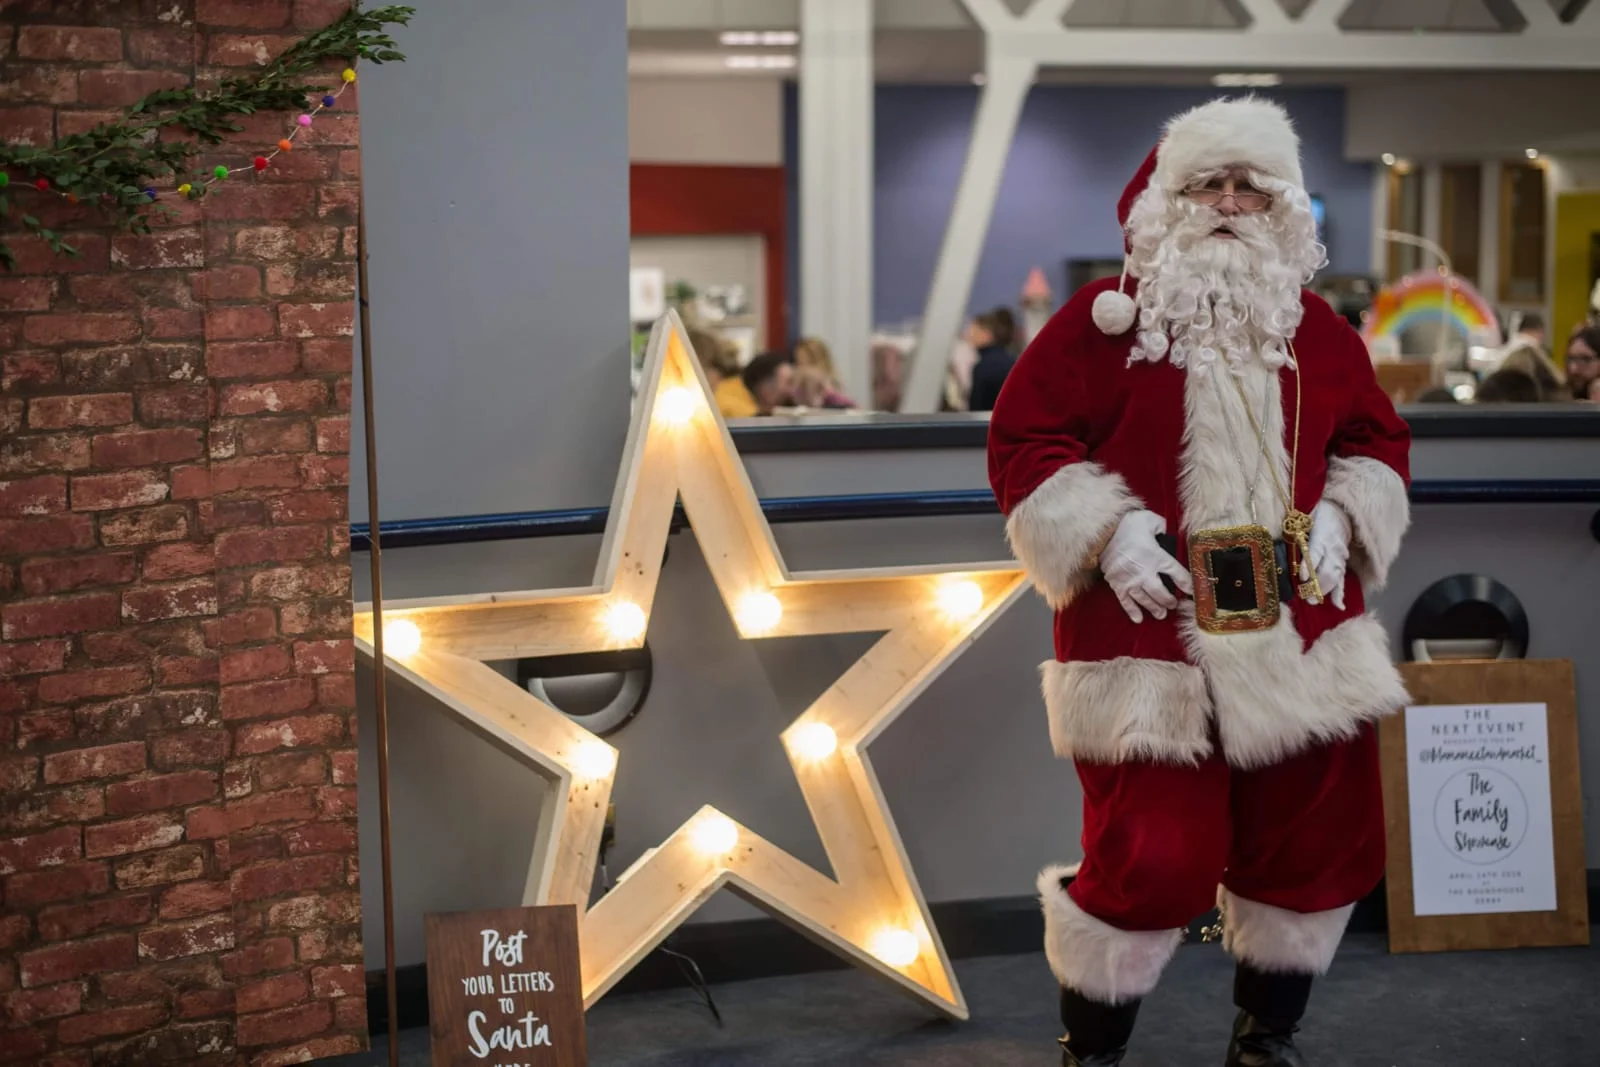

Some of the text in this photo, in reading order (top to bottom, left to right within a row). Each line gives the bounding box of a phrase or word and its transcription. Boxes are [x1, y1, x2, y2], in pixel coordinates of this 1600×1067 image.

[1463, 709, 1490, 720] THE
[1431, 722, 1524, 735] NEXT EVENT
[1468, 772, 1493, 795] The
[1455, 798, 1509, 832] Family
[480, 929, 528, 967] Post
[461, 971, 555, 996] YOUR LETTERS
[498, 997, 514, 1014] TO
[467, 1010, 552, 1058] Santa
